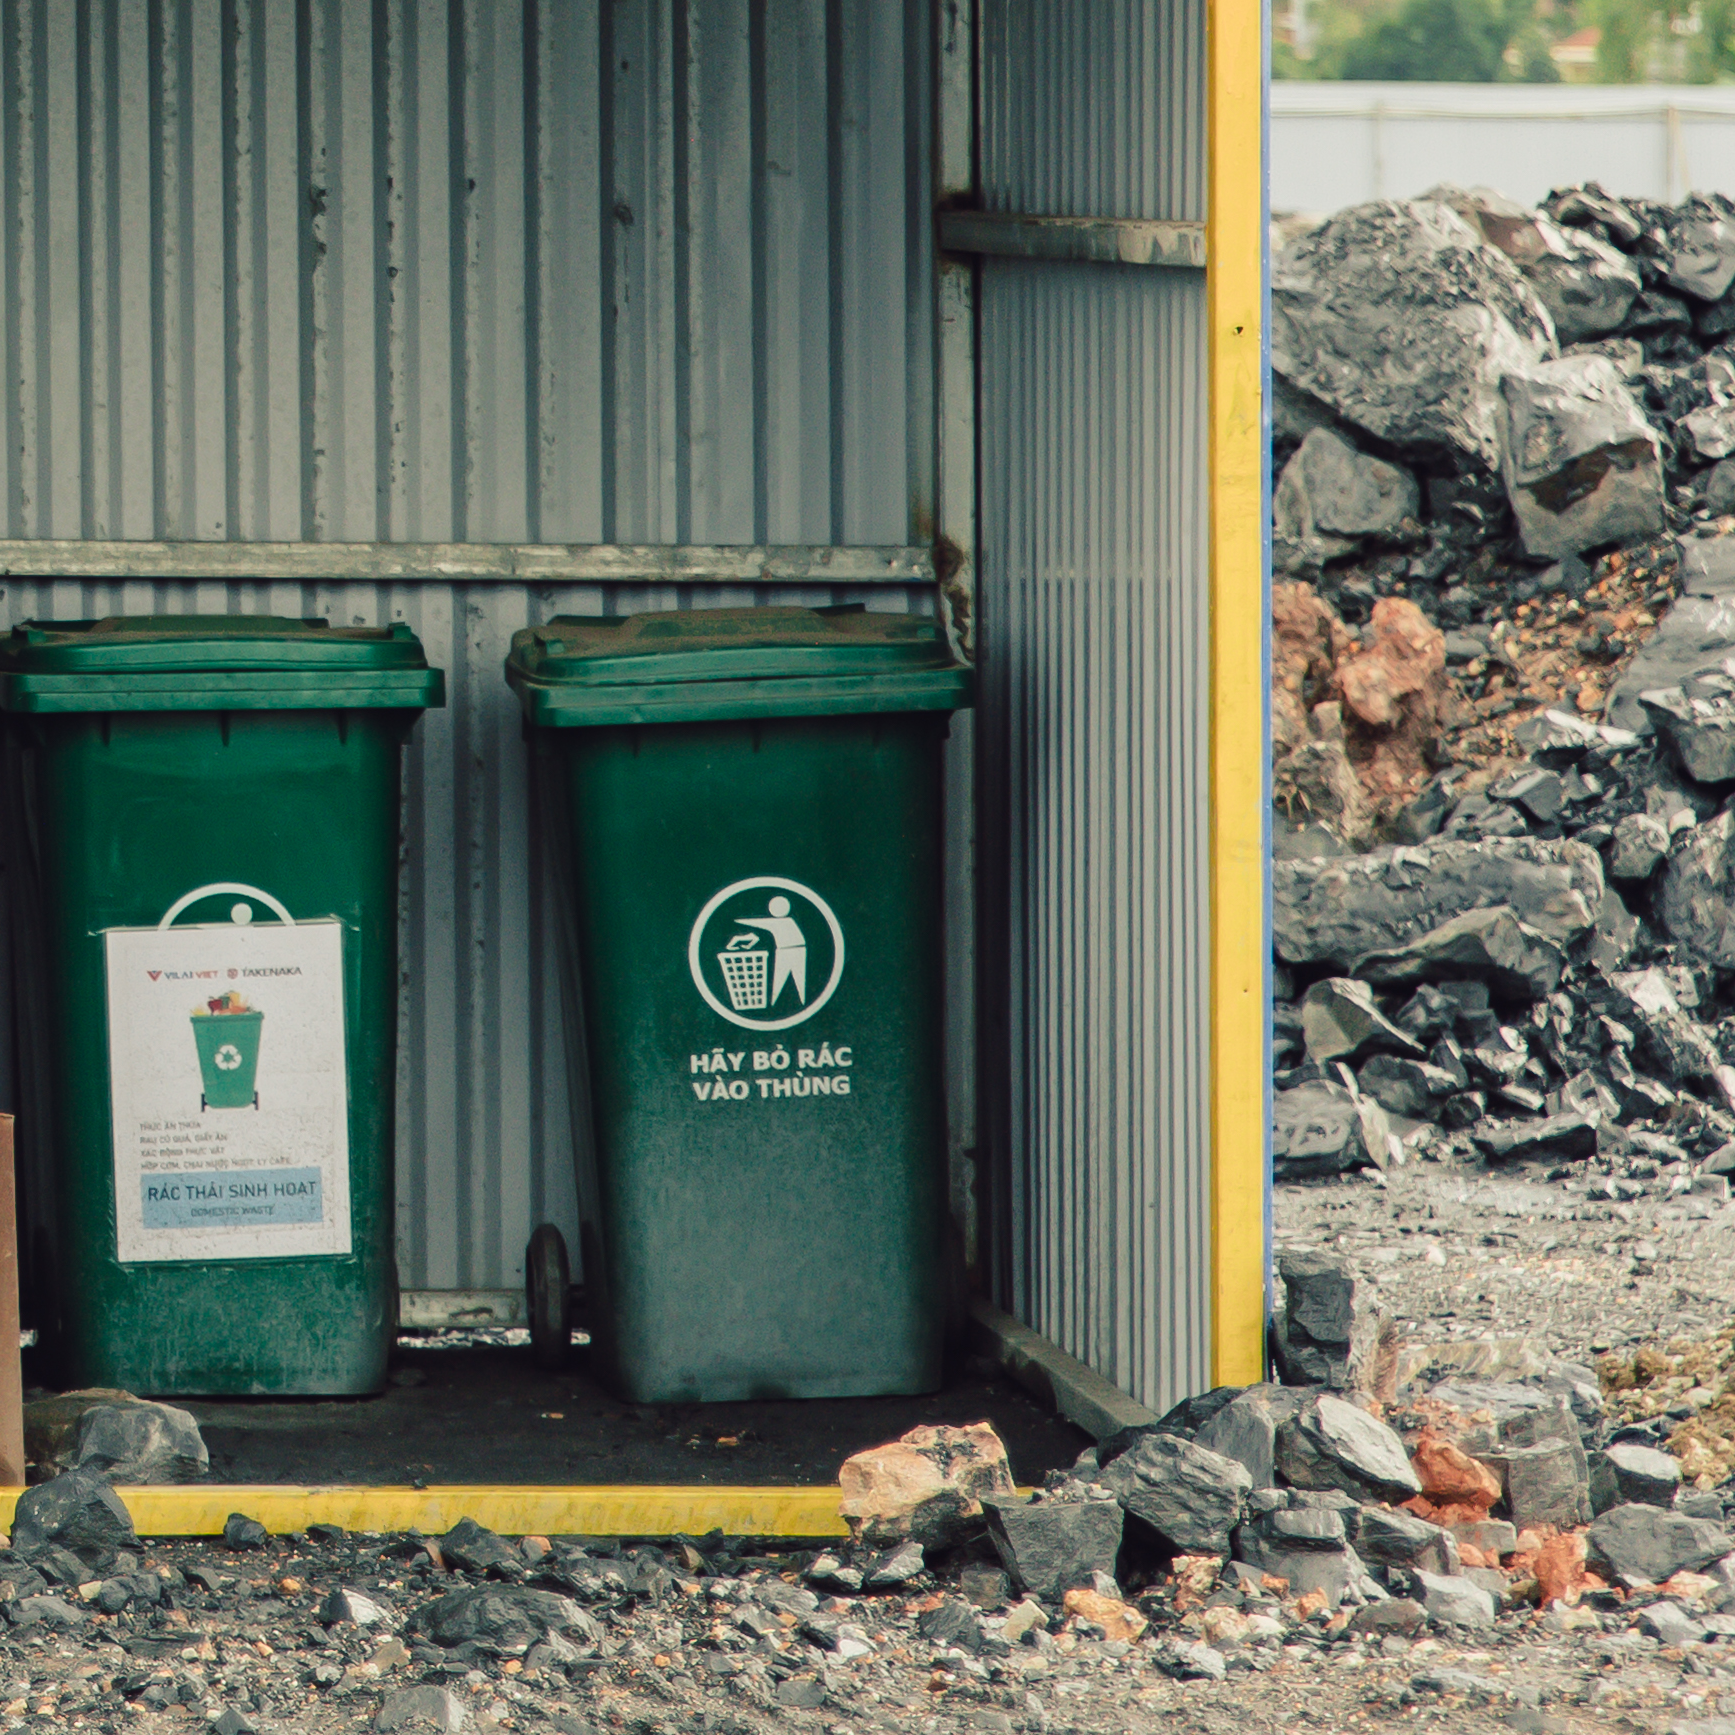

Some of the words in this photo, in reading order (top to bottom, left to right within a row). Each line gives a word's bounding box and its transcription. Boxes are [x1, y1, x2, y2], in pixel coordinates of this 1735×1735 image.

[242, 967, 302, 978] TAKENAKA
[690, 1047, 746, 1074] HÃY
[797, 1041, 853, 1069] RÁC
[692, 1074, 750, 1101] VÀO
[755, 1070, 851, 1099] THÙNG
[148, 1183, 180, 1201] RÁC
[185, 1182, 223, 1200] THẢI
[229, 1183, 267, 1199] SINH
[191, 1206, 239, 1217] DOMESTIC
